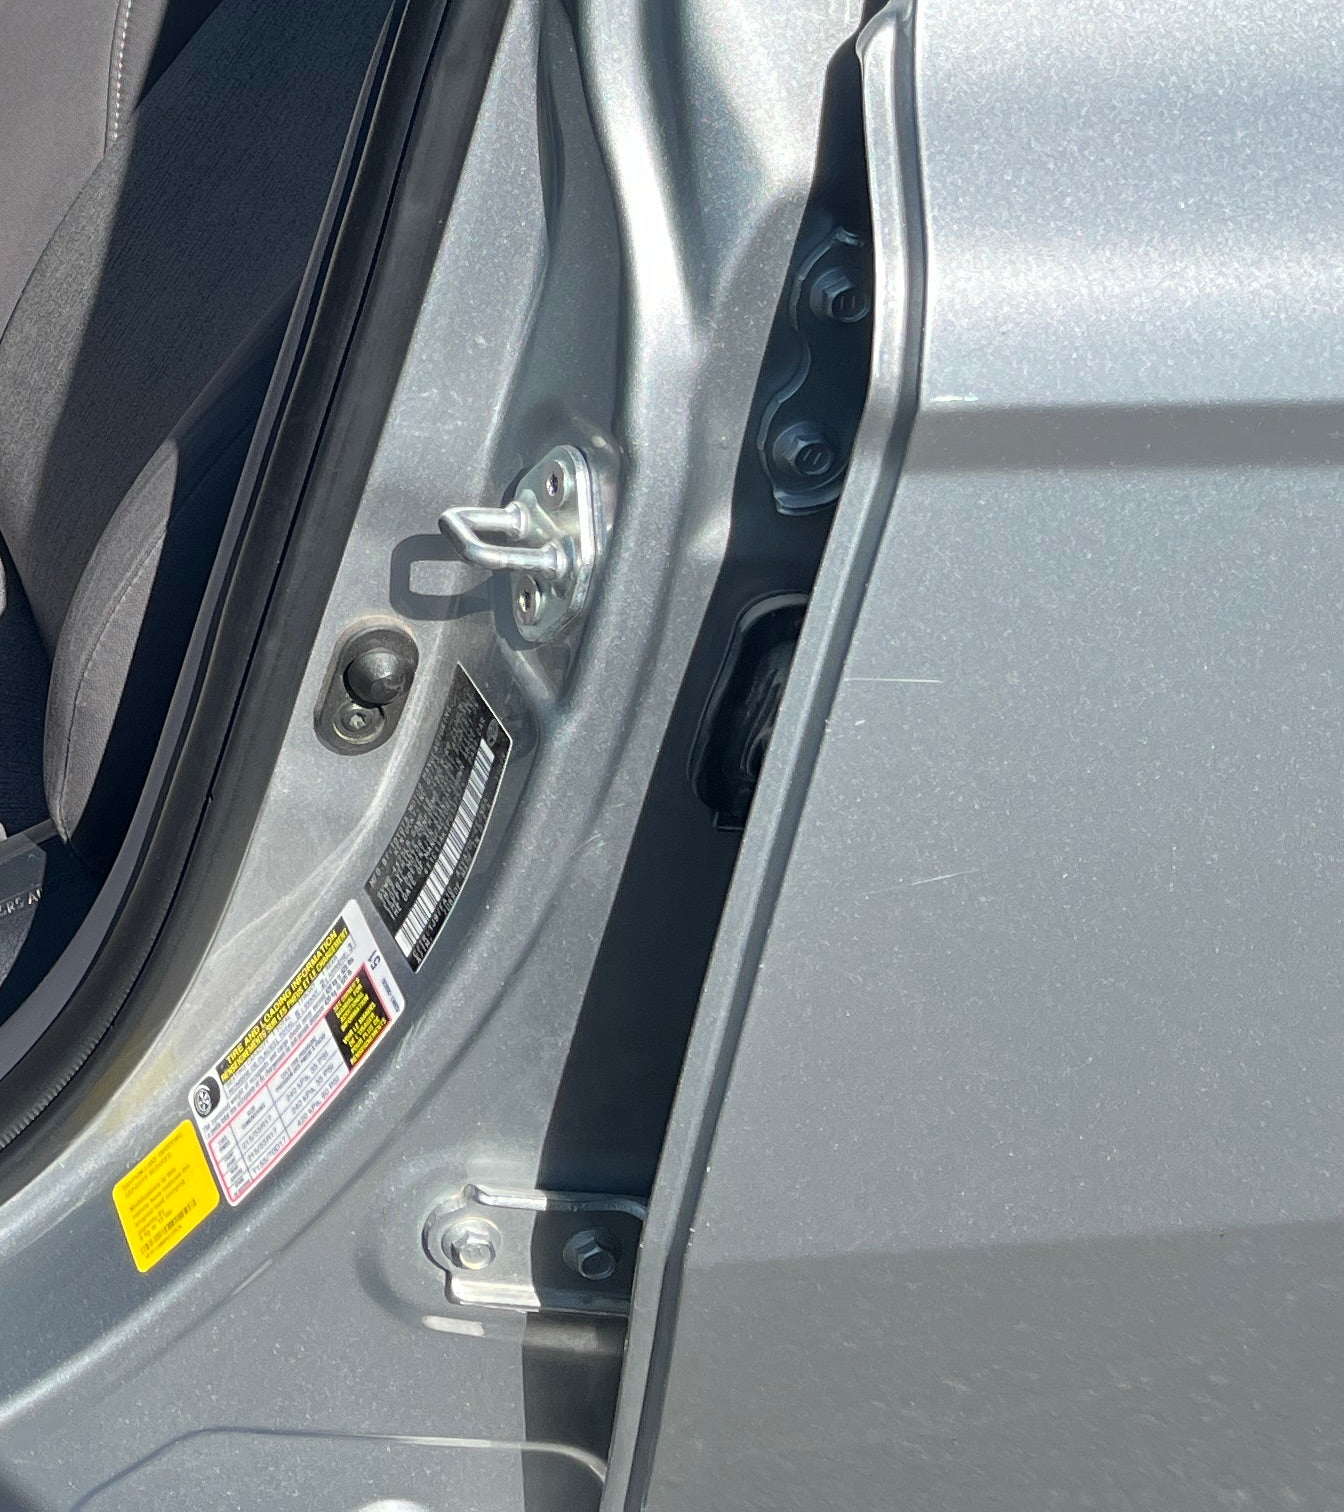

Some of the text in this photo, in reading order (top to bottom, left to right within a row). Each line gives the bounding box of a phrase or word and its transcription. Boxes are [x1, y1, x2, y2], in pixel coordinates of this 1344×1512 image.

[226, 928, 337, 1065] TIRE AND LOADING INFORMATION
[367, 949, 381, 970] 51
